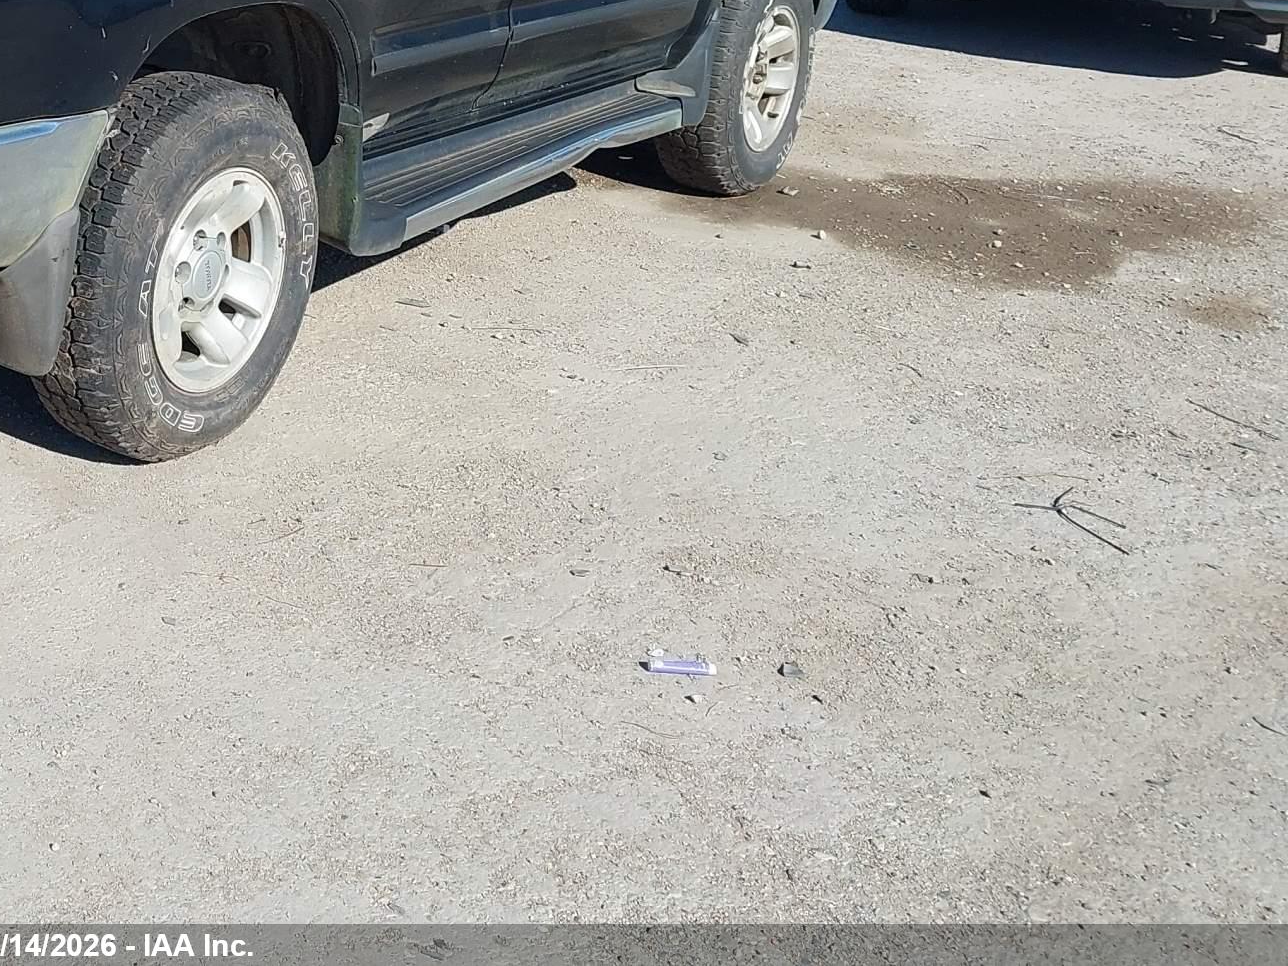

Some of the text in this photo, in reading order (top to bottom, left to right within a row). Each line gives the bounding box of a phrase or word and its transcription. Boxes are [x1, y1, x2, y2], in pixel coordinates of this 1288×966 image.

[270, 141, 316, 291] KELLY
[136, 232, 205, 433] EDGE AT
